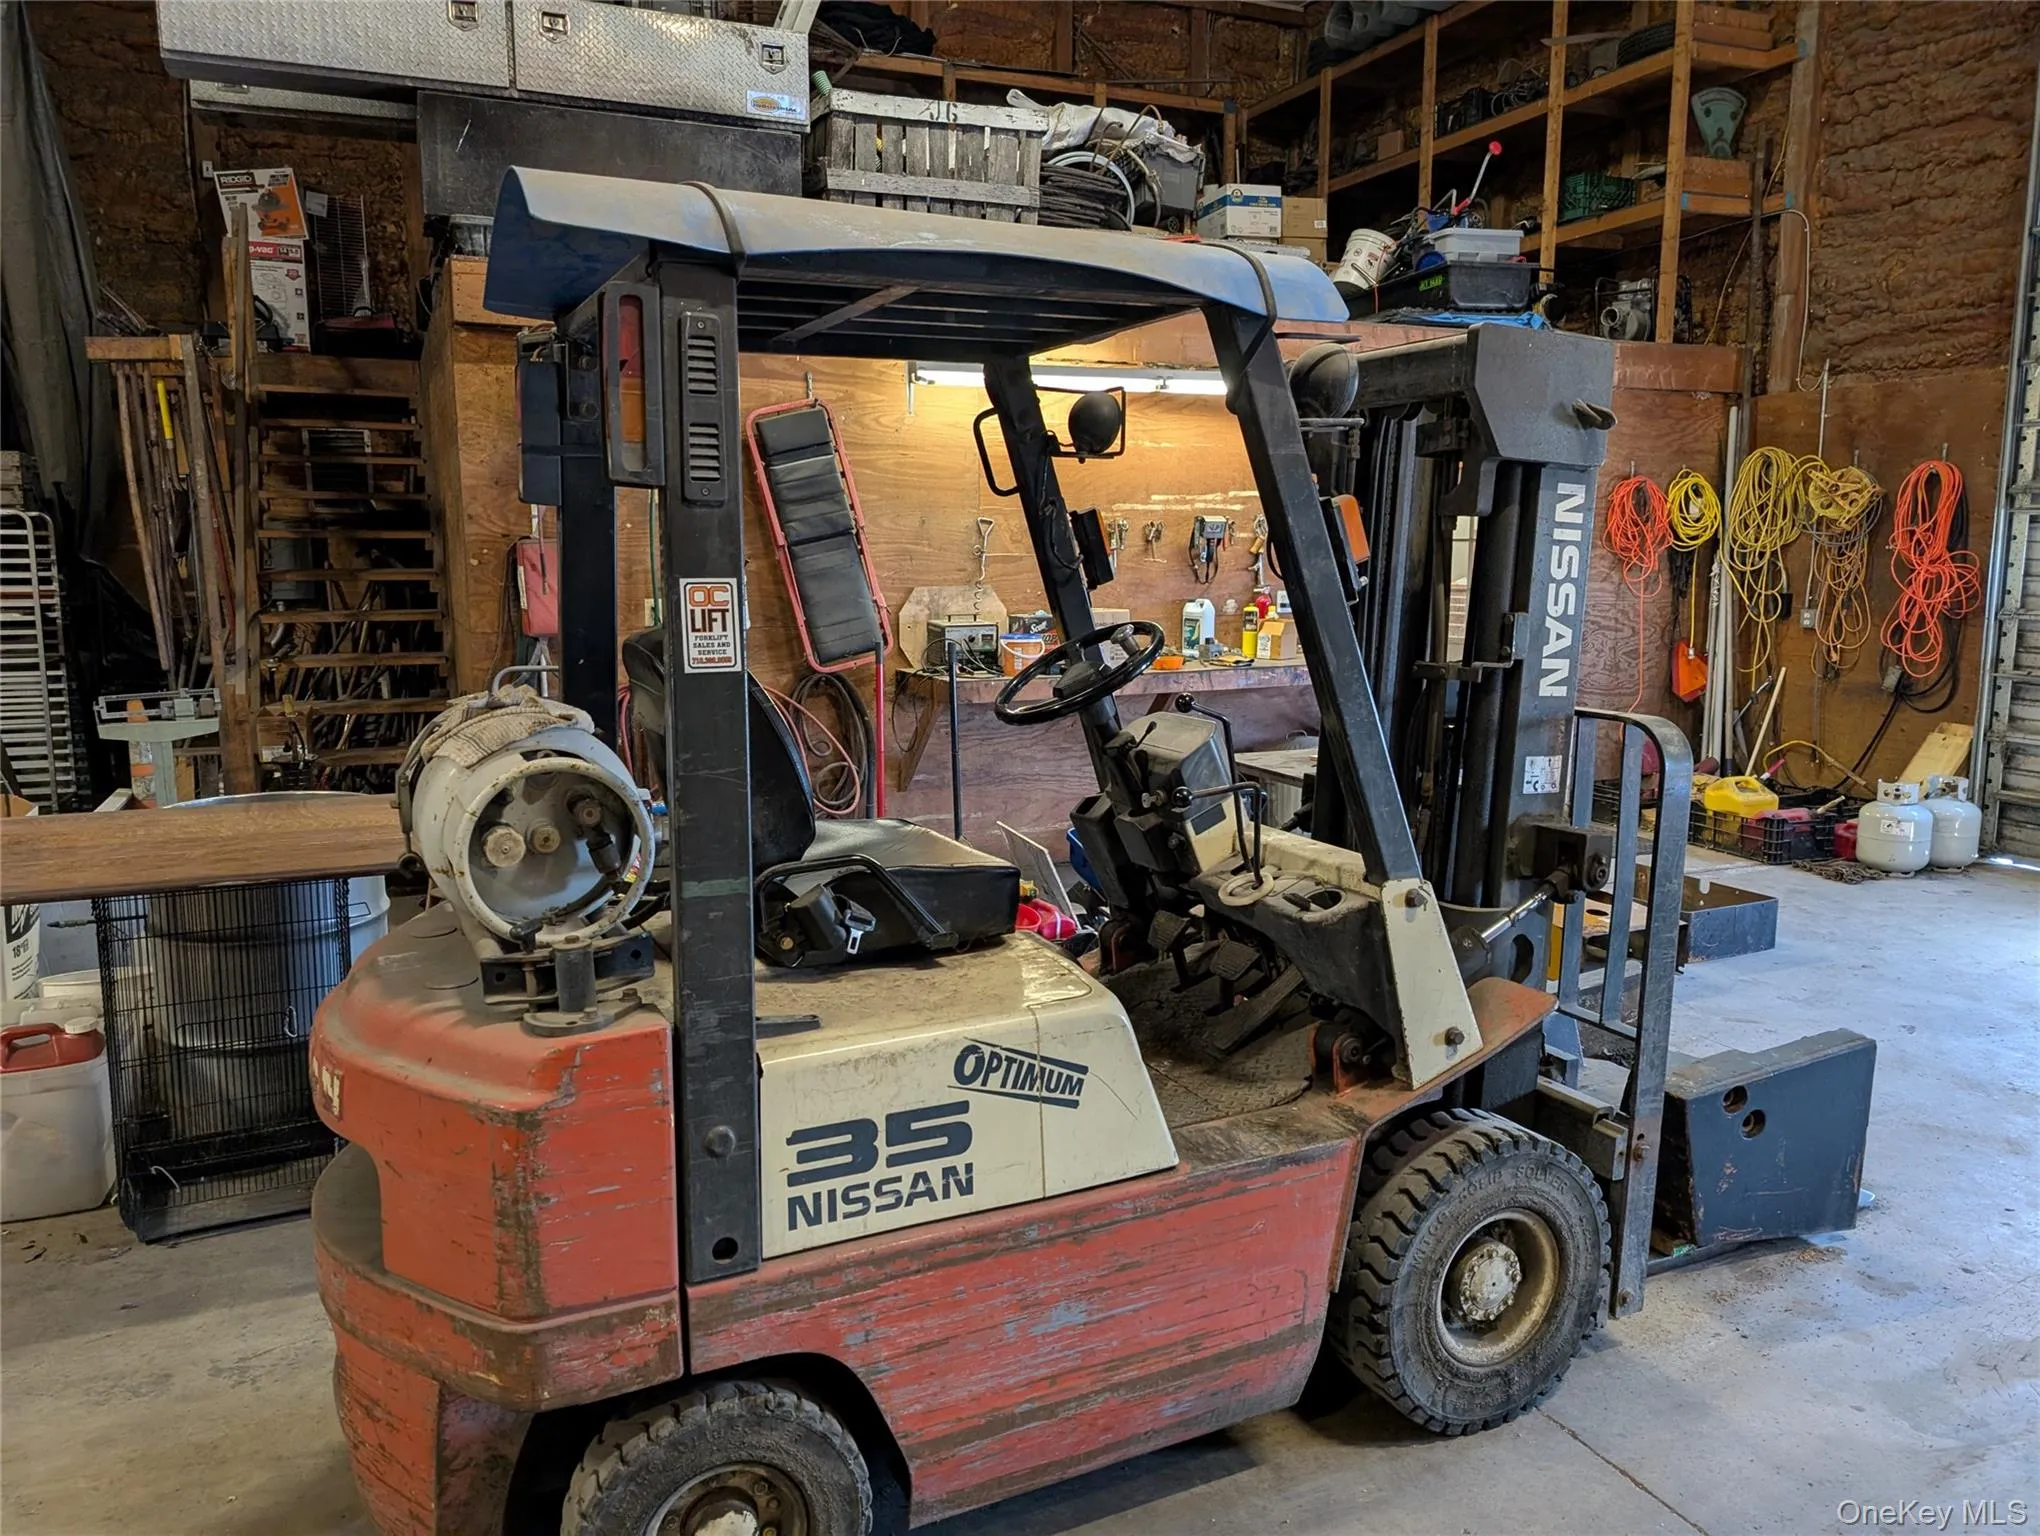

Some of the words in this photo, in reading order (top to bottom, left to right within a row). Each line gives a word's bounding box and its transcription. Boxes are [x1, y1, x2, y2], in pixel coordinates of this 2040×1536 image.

[688, 586, 729, 607] OC
[1539, 482, 1586, 697] NISSAN
[690, 608, 730, 633] LIFT
[692, 641, 716, 649] SALES
[953, 1044, 1086, 1097] OPTIMUM
[785, 1099, 974, 1188] 35
[787, 1162, 974, 1232] NISSAN
